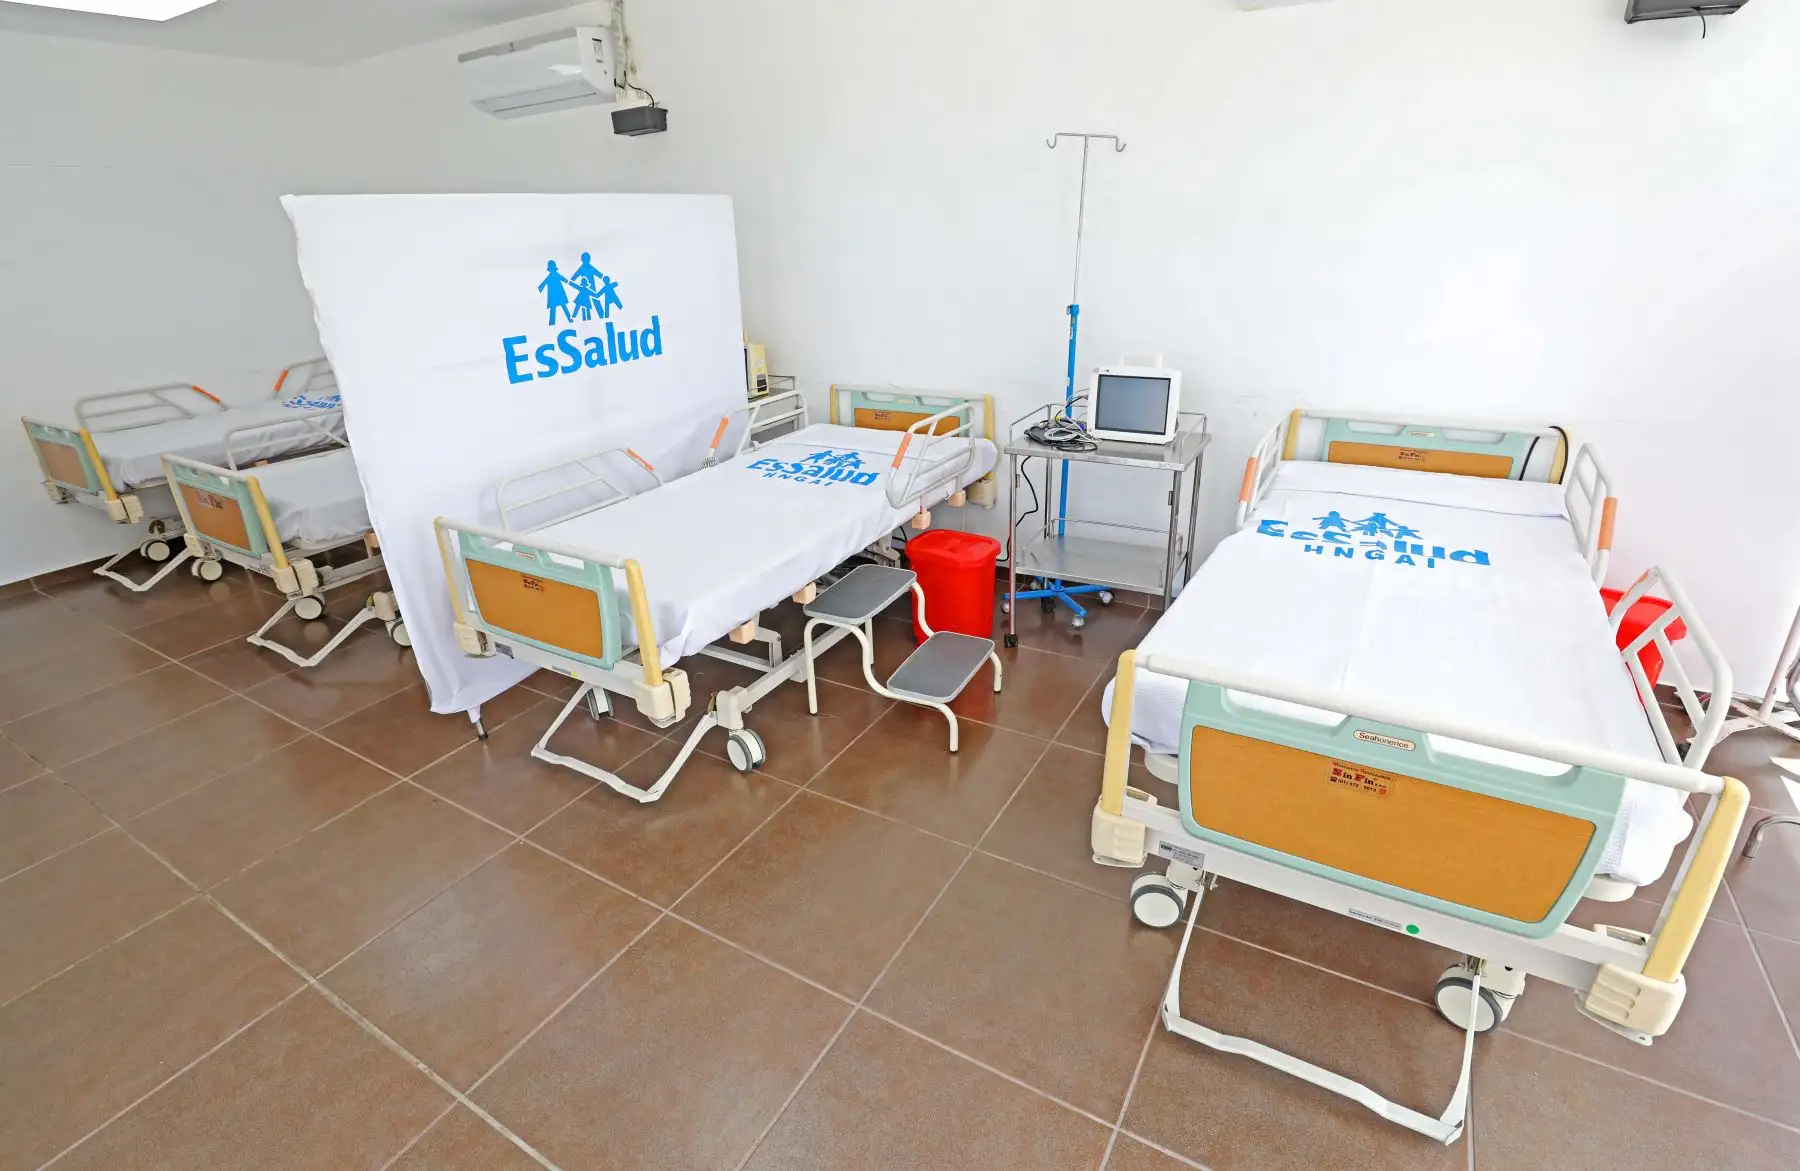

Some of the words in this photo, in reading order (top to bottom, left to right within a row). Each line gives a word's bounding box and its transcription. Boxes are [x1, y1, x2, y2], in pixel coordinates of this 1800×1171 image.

[501, 314, 664, 385] EsSalud
[747, 458, 880, 487] EsSalud
[1303, 543, 1436, 569] HNGAI
